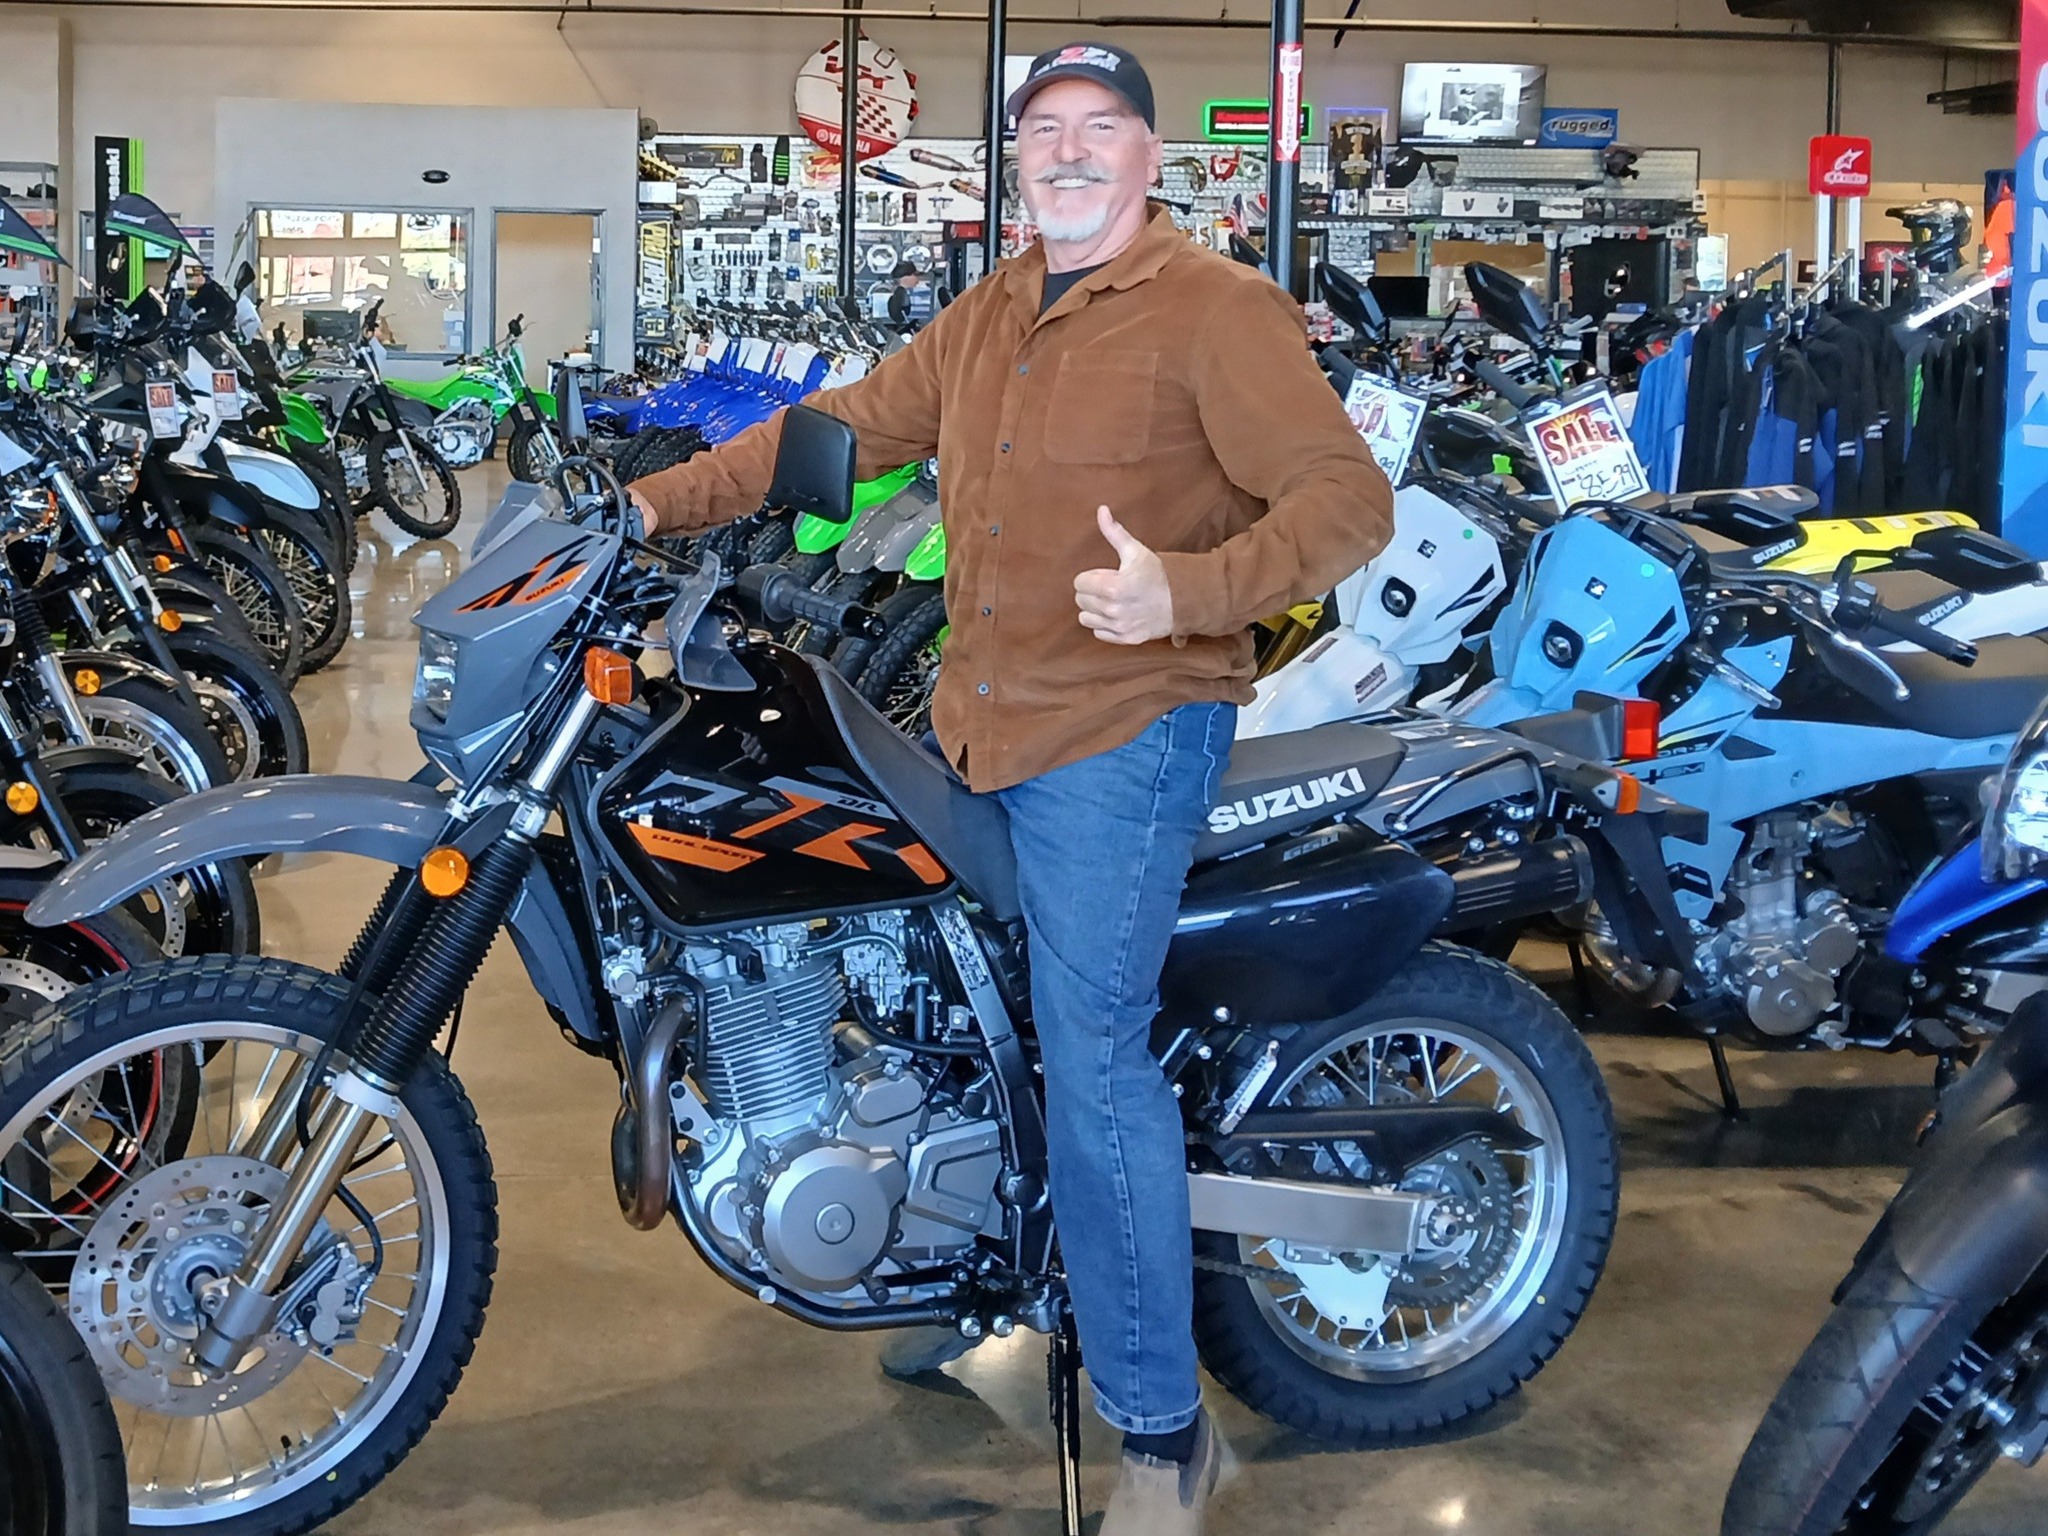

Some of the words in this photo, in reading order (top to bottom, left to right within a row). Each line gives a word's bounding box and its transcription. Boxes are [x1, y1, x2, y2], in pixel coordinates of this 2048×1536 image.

[1551, 119, 1610, 133] rugged
[829, 131, 871, 154] YAHA
[2022, 61, 2048, 446] ZUKI
[1542, 414, 1619, 466] SALE
[1752, 538, 1797, 564] SUZUKI
[525, 578, 565, 602] SUZUKI
[1918, 595, 1964, 626] SUZUKI
[1207, 767, 1366, 834] SUZUKI
[652, 833, 696, 848] DUAL
